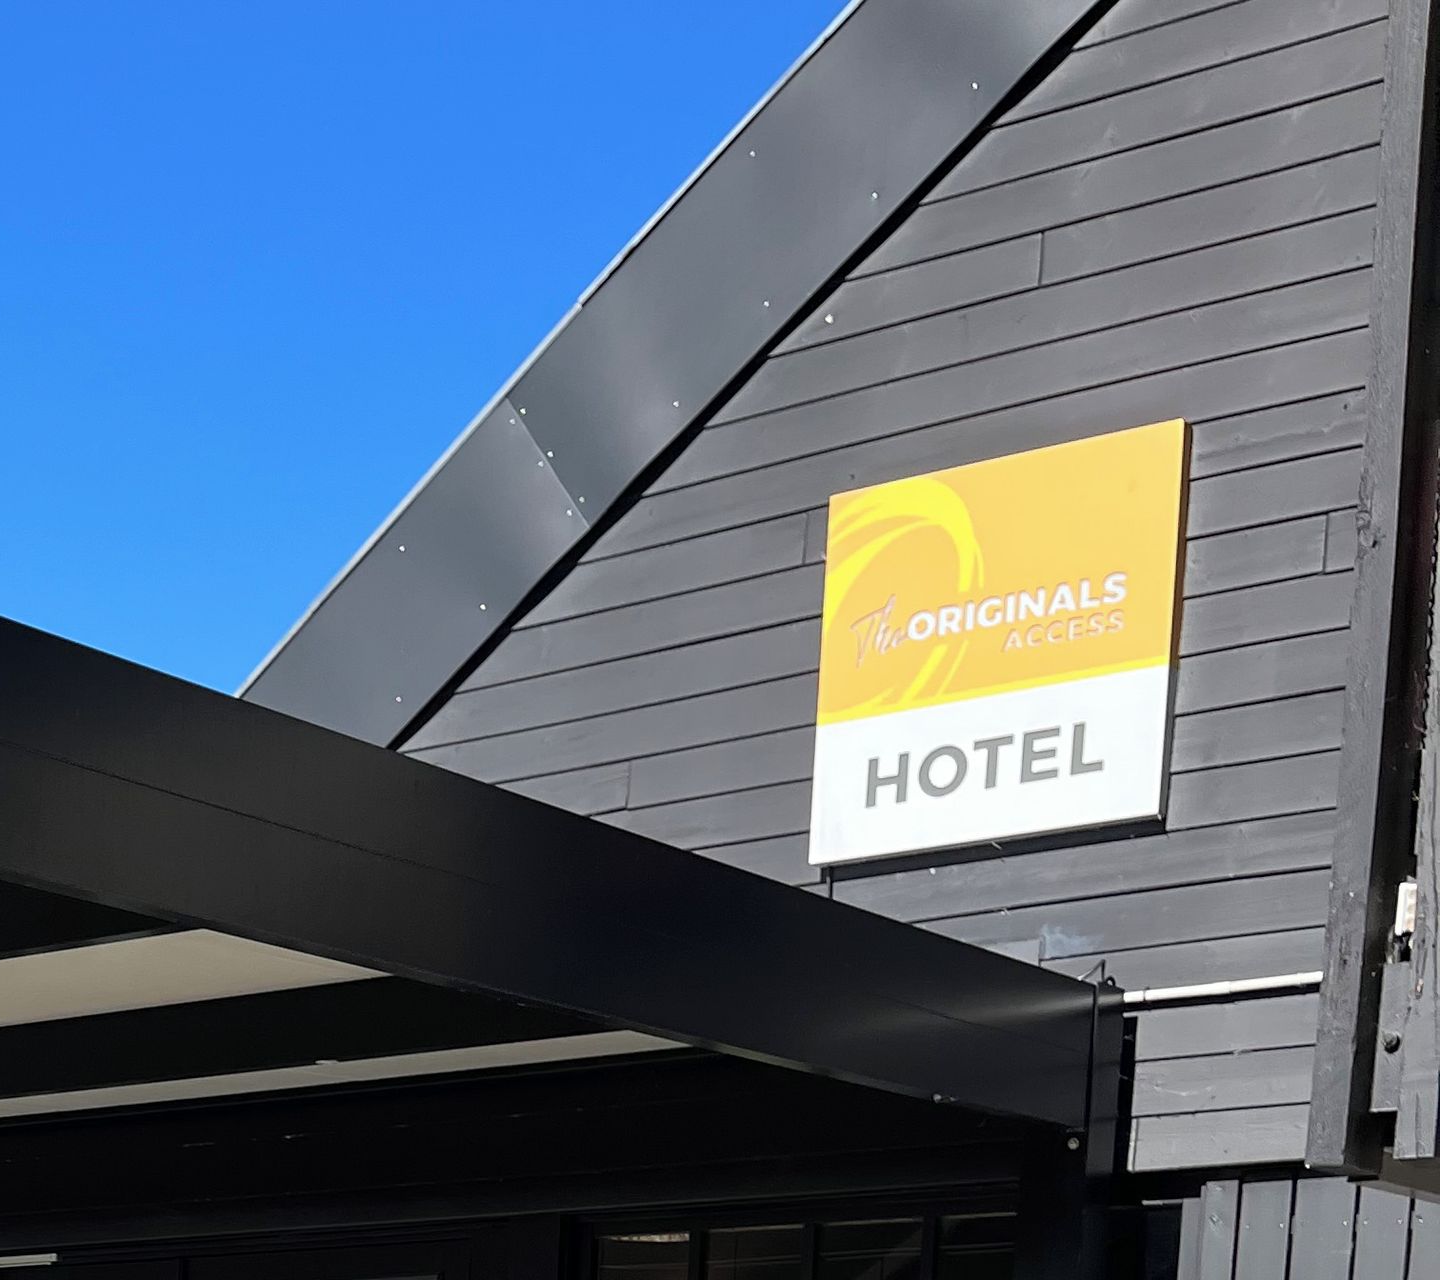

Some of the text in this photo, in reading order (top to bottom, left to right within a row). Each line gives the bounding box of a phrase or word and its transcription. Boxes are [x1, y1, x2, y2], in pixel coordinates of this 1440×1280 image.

[850, 571, 1127, 669] The ORIGINALS
[1002, 609, 1124, 652] ACCESS
[866, 722, 1104, 808] HOTEL
